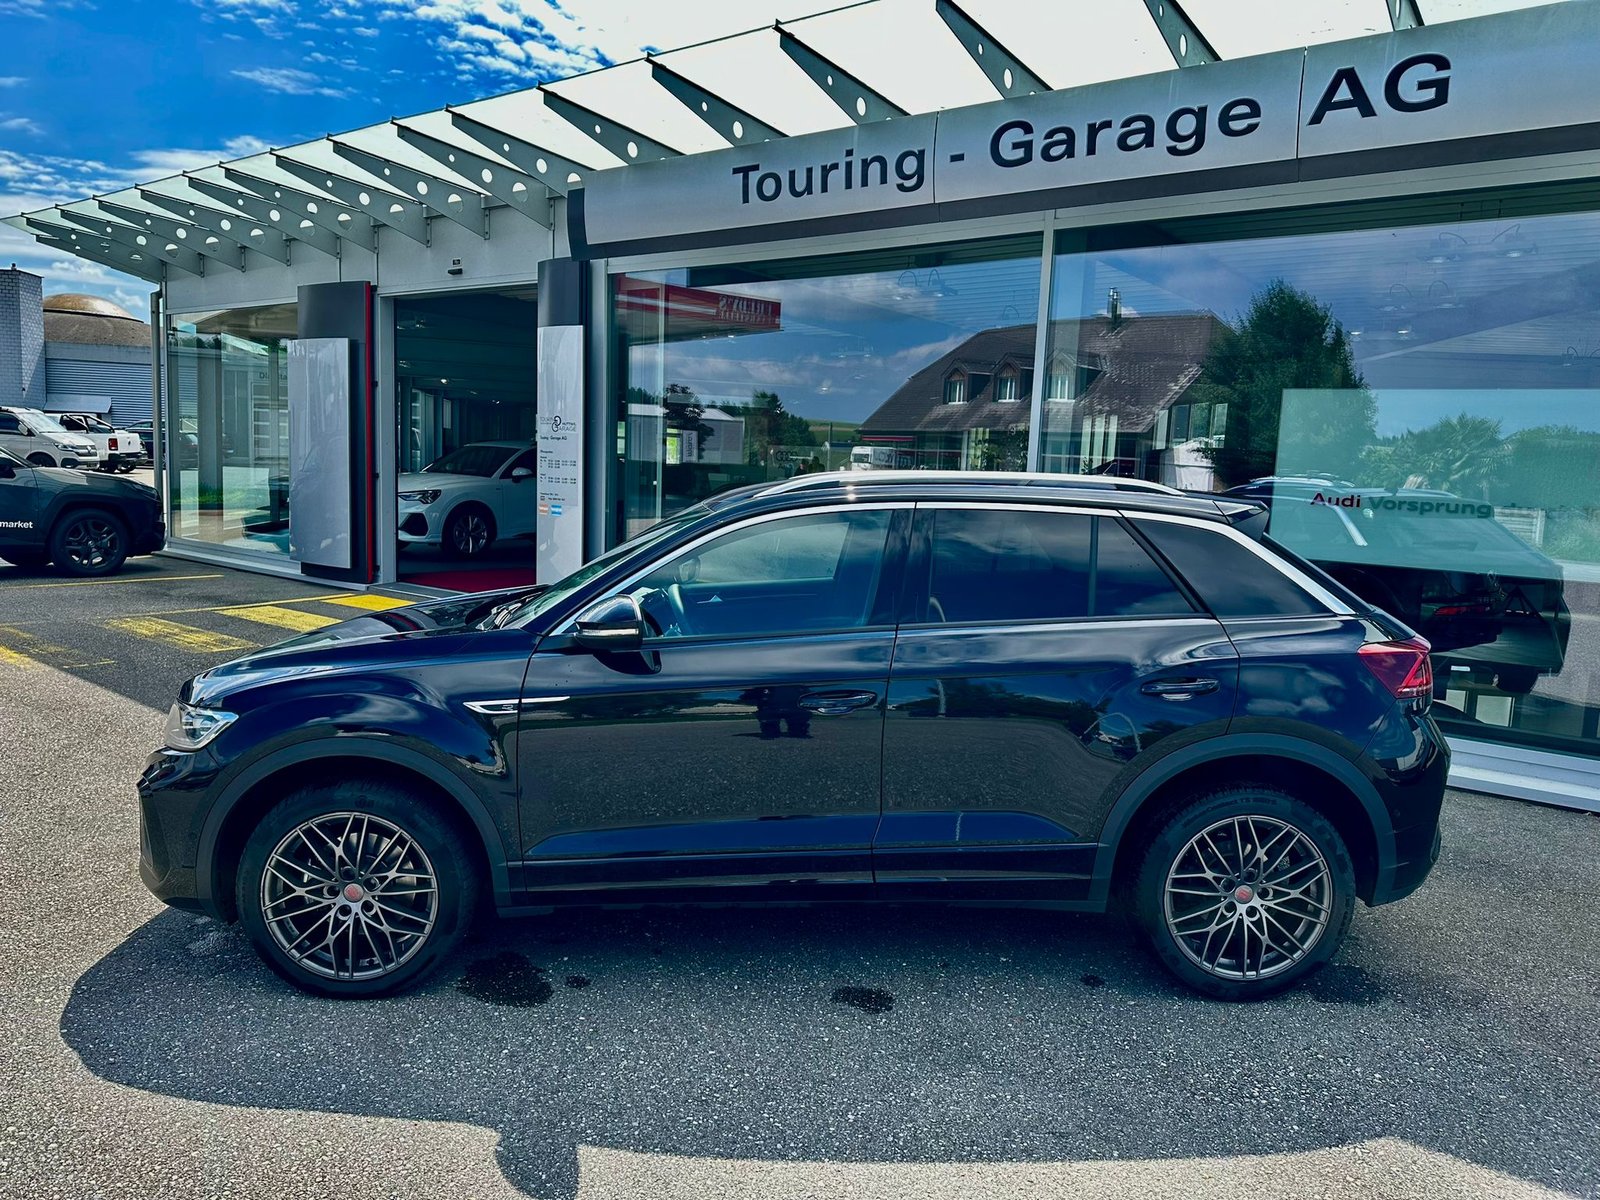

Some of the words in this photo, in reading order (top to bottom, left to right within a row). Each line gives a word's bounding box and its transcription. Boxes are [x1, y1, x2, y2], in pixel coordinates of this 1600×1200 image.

[732, 148, 925, 204] Touring
[989, 97, 1261, 168] Garage
[1306, 53, 1451, 126] AG
[1310, 492, 1361, 508] Audi
[1368, 497, 1492, 519] Vorsprung
[0, 520, 34, 529] market
